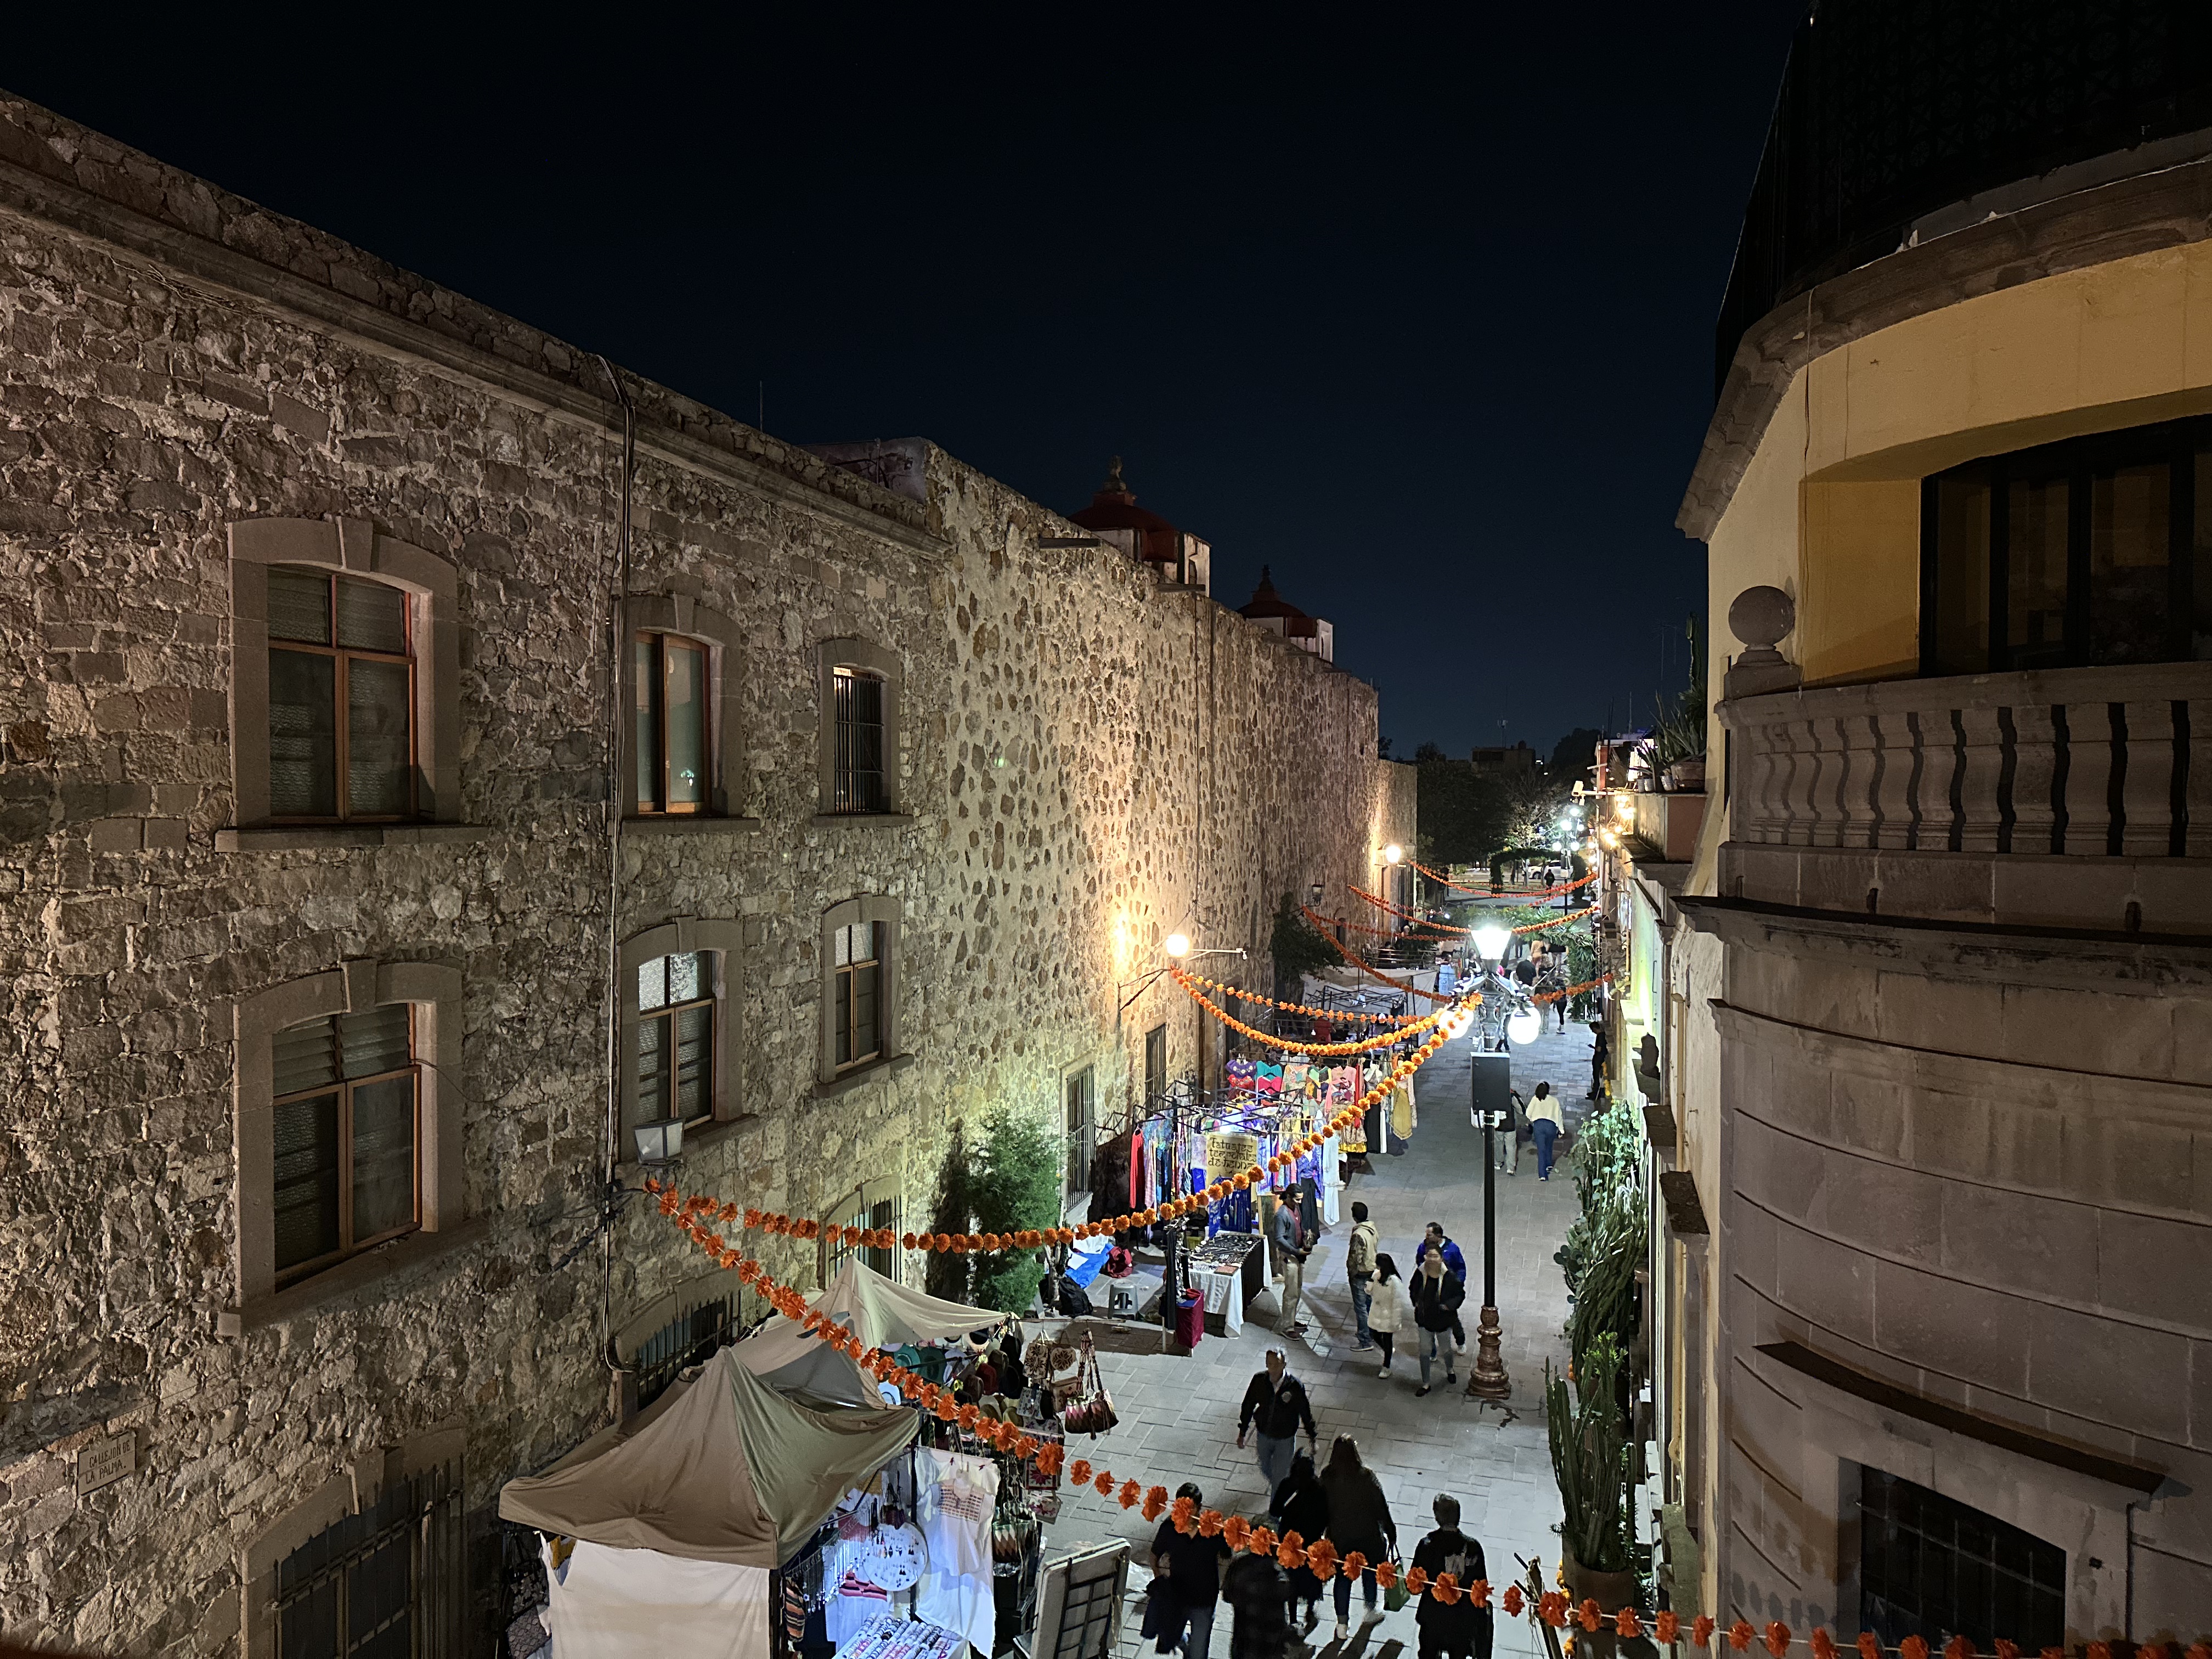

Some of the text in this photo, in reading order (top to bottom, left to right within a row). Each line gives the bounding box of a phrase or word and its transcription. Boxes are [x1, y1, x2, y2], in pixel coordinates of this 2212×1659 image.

[1209, 1147, 1257, 1162] temporales
[1210, 1137, 1254, 1153] Tatuajes
[89, 1440, 131, 1468] CALLEJON DE
[86, 1459, 126, 1485] LA PALMA.
